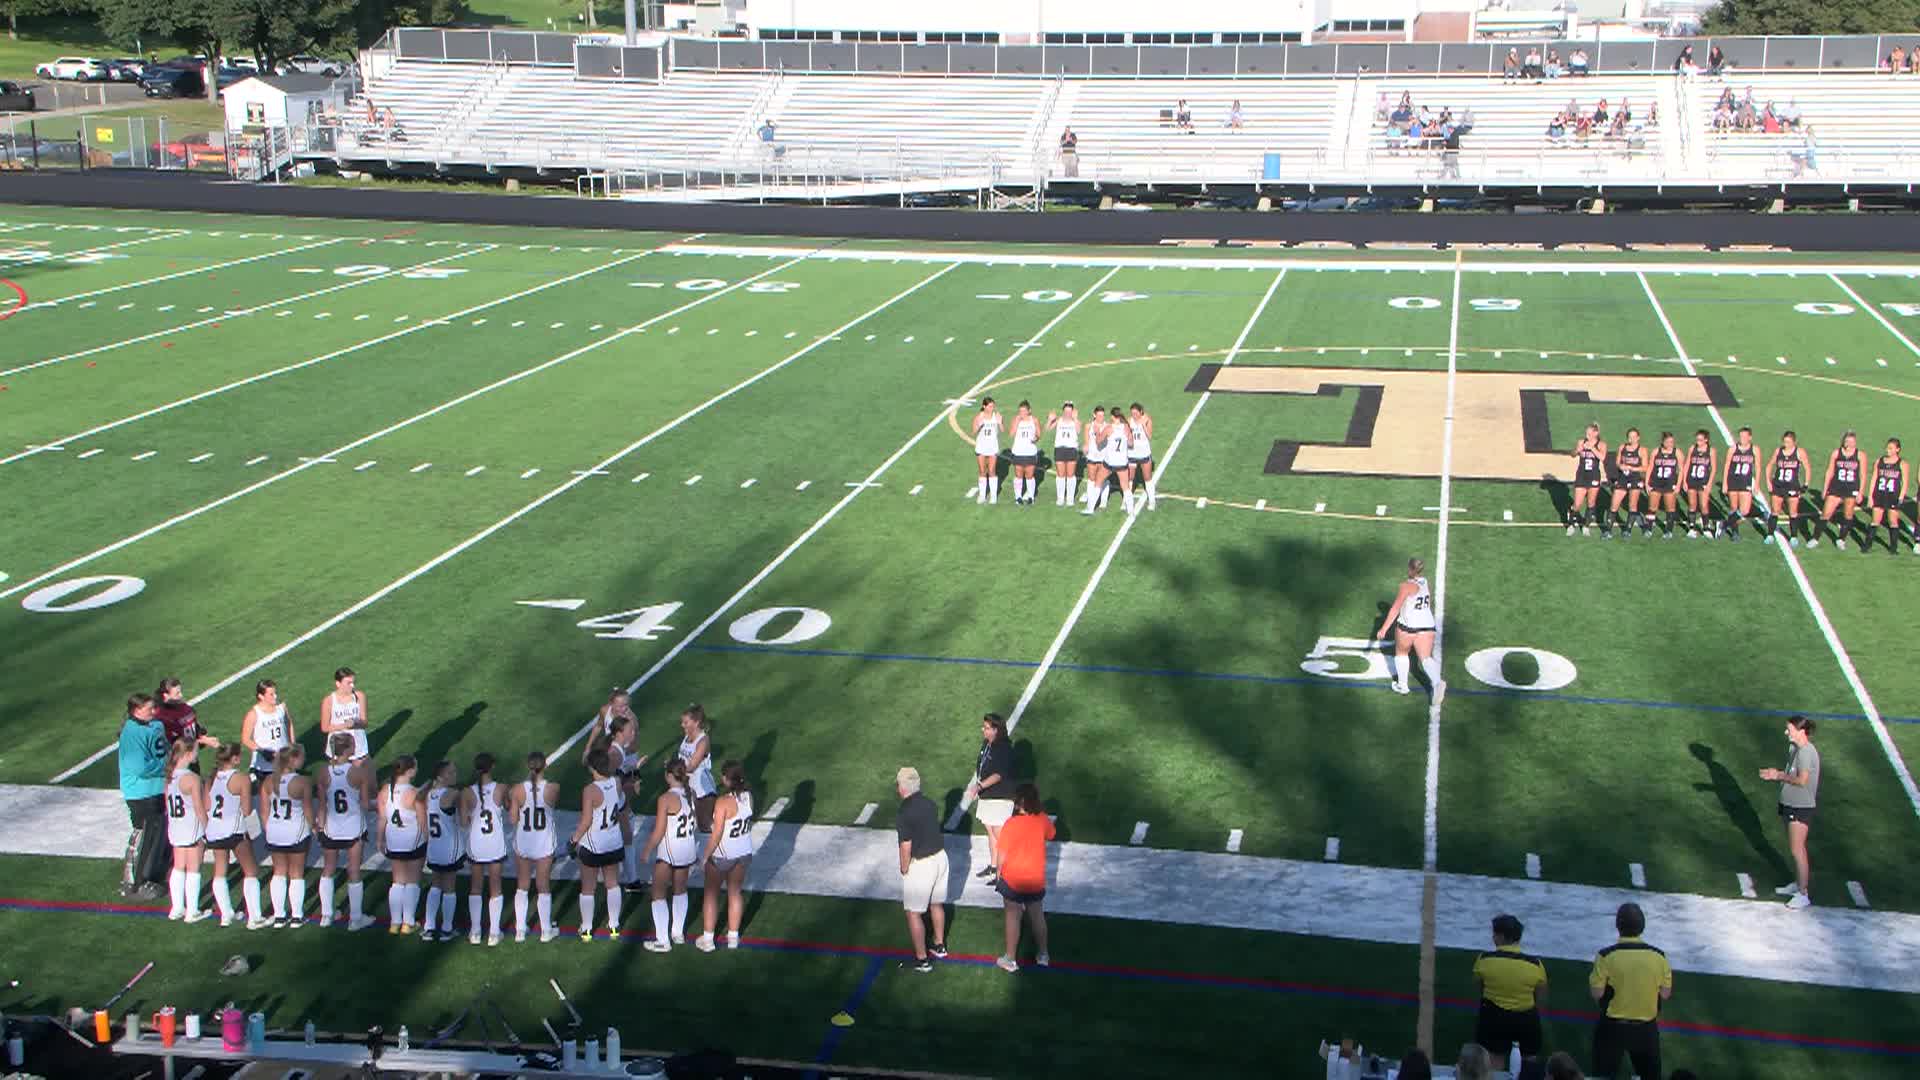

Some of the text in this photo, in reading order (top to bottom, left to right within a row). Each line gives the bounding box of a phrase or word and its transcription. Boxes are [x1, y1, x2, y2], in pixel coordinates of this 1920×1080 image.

[1584, 458, 1593, 471] 2
[1878, 477, 1895, 492] 24
[271, 727, 281, 740] 13
[212, 794, 224, 819] 2
[272, 797, 292, 820] 17
[334, 789, 348, 814] 6
[391, 809, 405, 828] 4
[429, 813, 441, 838] 5
[481, 809, 493, 834] 3
[523, 807, 547, 832] 10
[600, 803, 619, 830] 14
